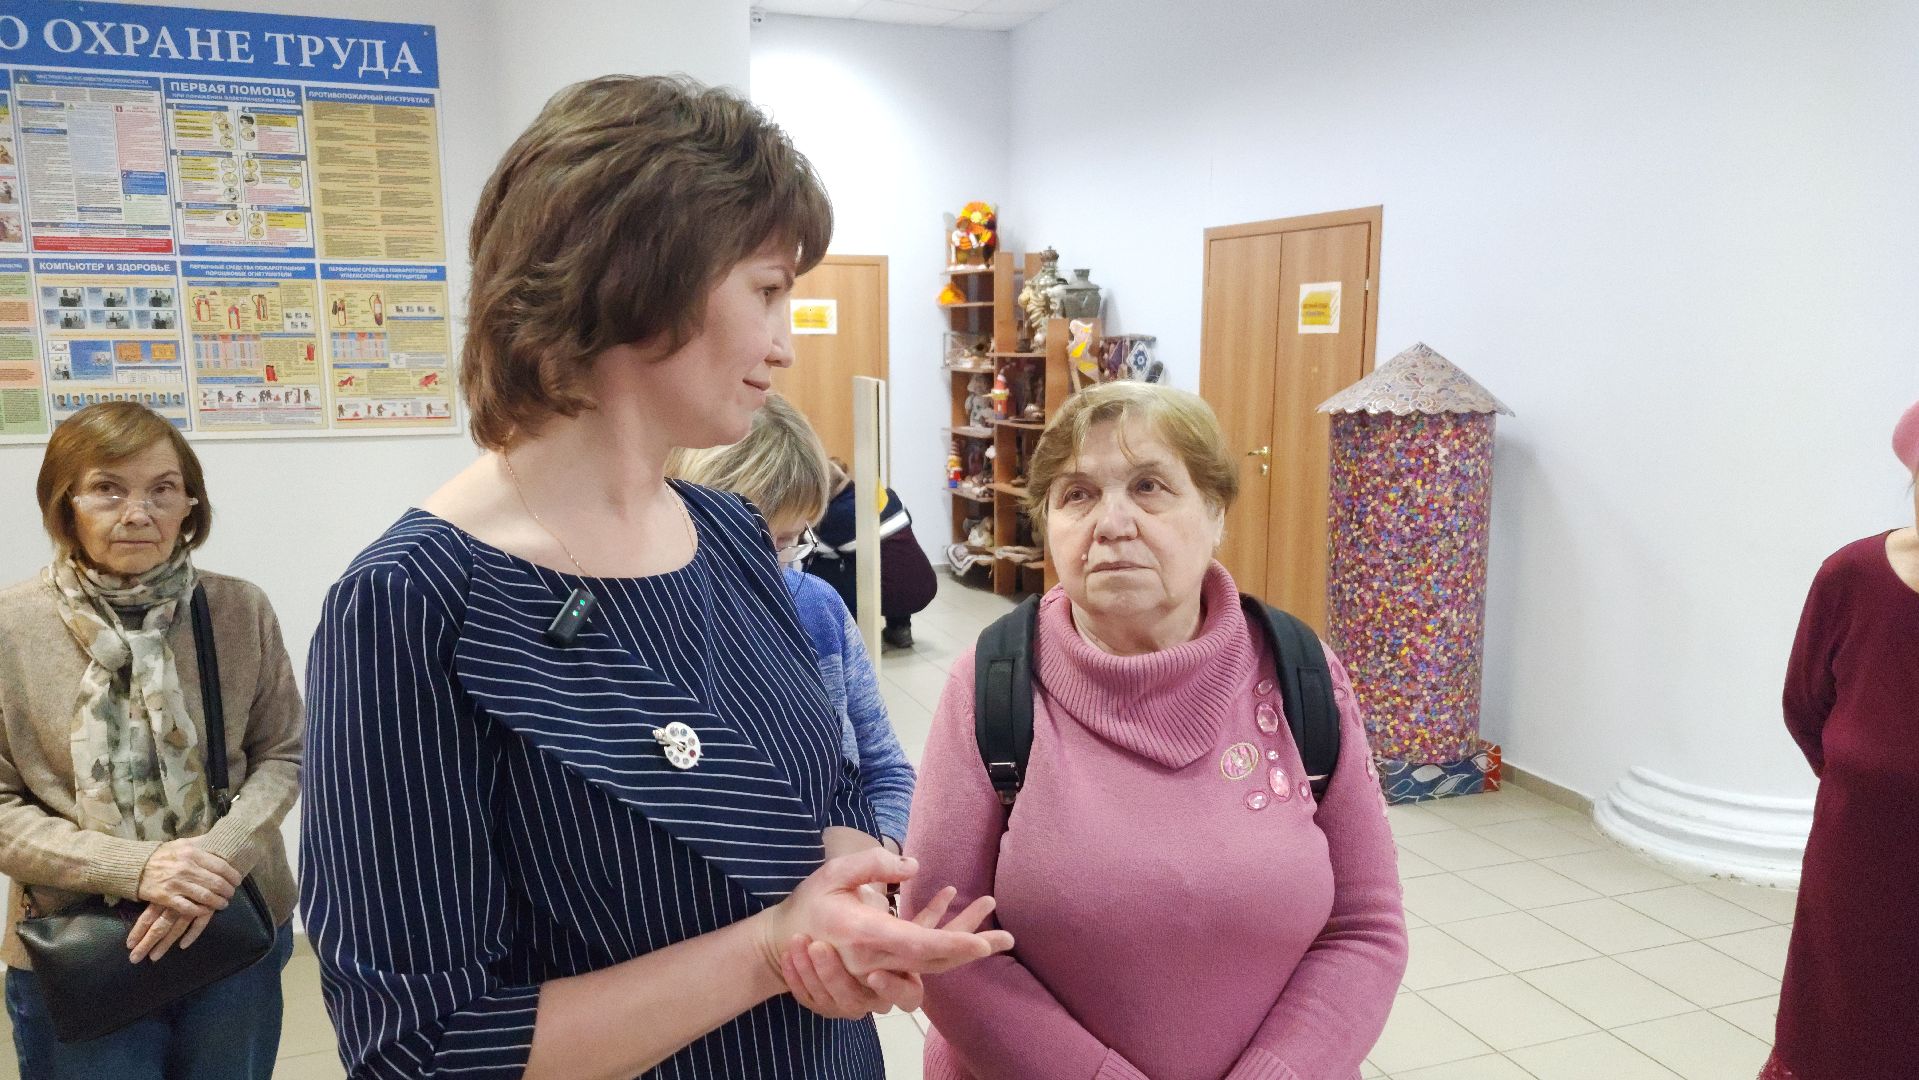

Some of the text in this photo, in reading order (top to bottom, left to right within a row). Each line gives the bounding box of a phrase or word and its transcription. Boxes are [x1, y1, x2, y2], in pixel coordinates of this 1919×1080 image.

[43, 18, 255, 63] ОХРАНЕ
[264, 32, 422, 79] ТРУДА
[170, 81, 296, 97] ПЕРВАЯ ПОМОЩЬ
[308, 91, 430, 104] ПРОТИВОПОЖАРНЫЙ ИНСТРУКТАЖ
[39, 262, 171, 272] КОМПЬЮТЕР И ЗДОРОВЬЕ
